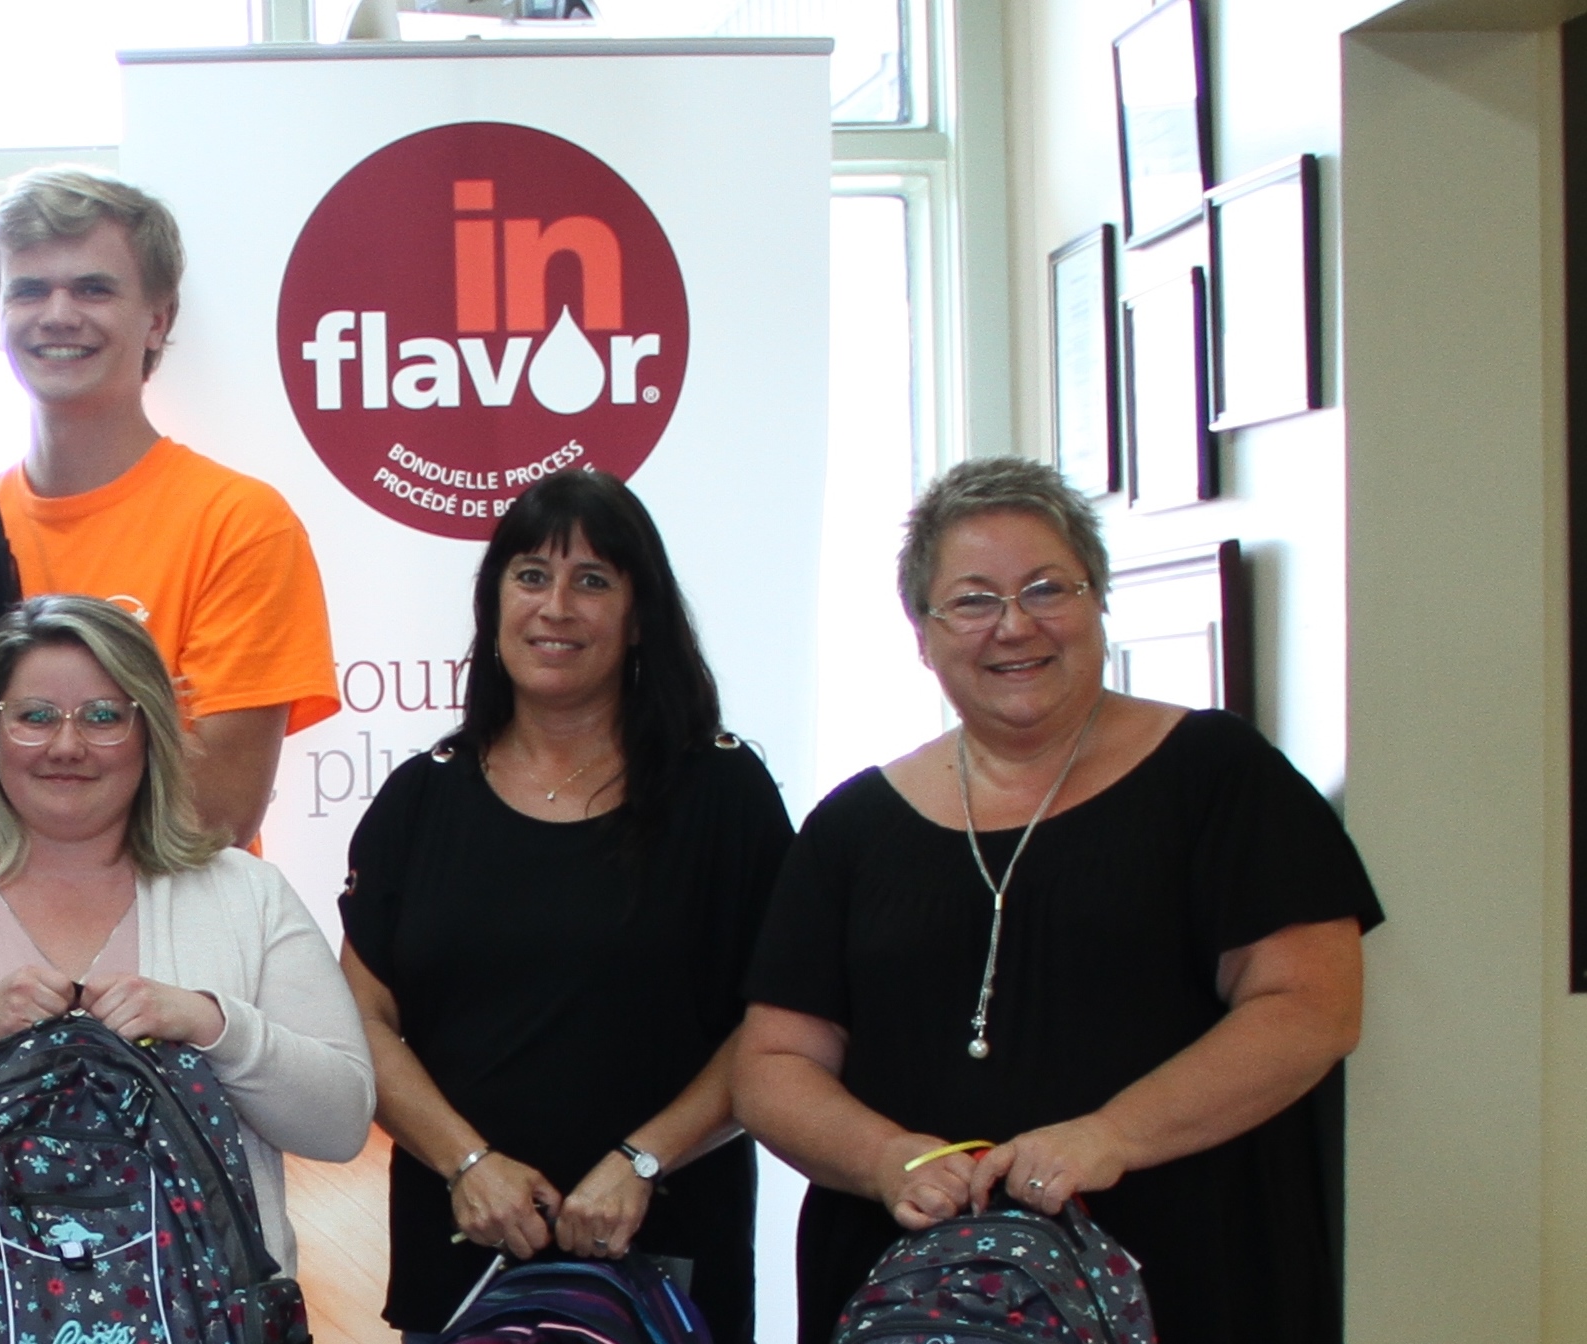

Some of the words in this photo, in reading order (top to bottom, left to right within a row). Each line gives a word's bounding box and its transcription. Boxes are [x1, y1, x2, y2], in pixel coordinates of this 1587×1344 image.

[453, 179, 624, 333] in
[387, 442, 499, 490] BONDUELLE
[504, 438, 585, 488] PROCESS
[373, 466, 458, 516] PROCÉDÉ
[462, 499, 488, 518] DE
